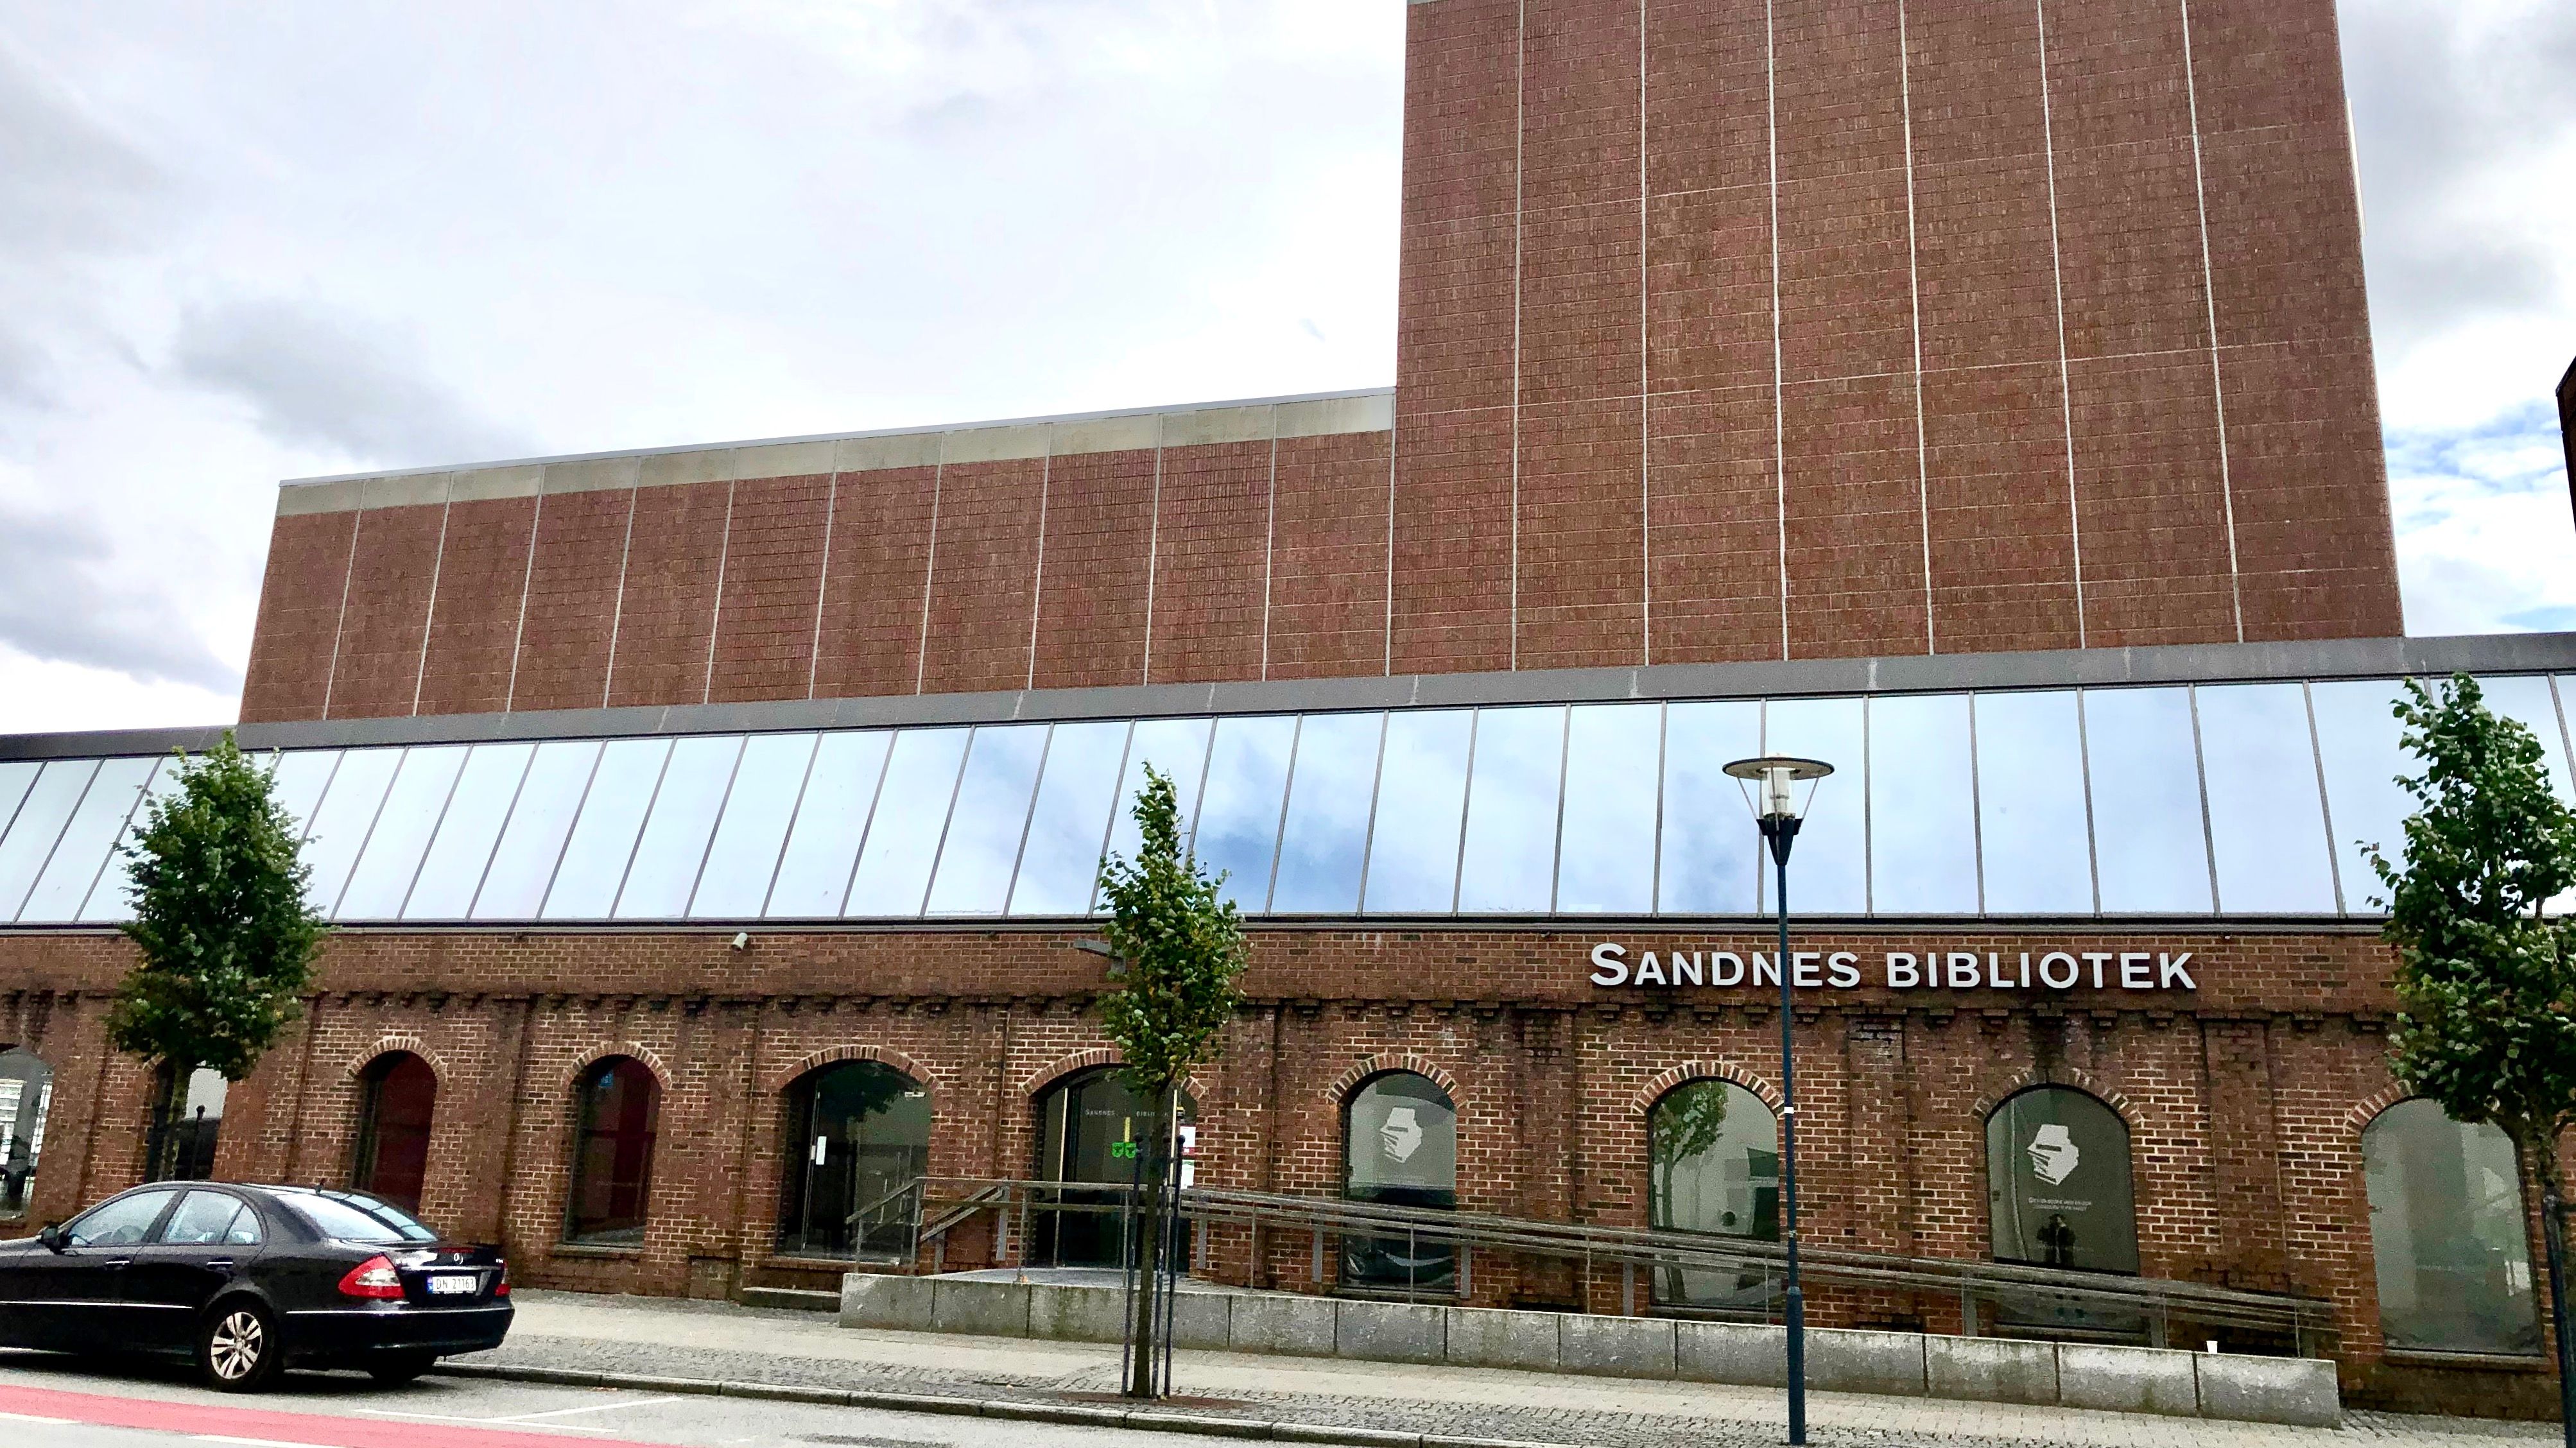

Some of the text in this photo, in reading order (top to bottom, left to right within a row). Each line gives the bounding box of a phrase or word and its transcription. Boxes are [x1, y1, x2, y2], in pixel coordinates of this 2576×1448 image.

[1589, 943, 2197, 989] SANDNES BIBLIOTEK
[453, 1278, 474, 1289] 21163
